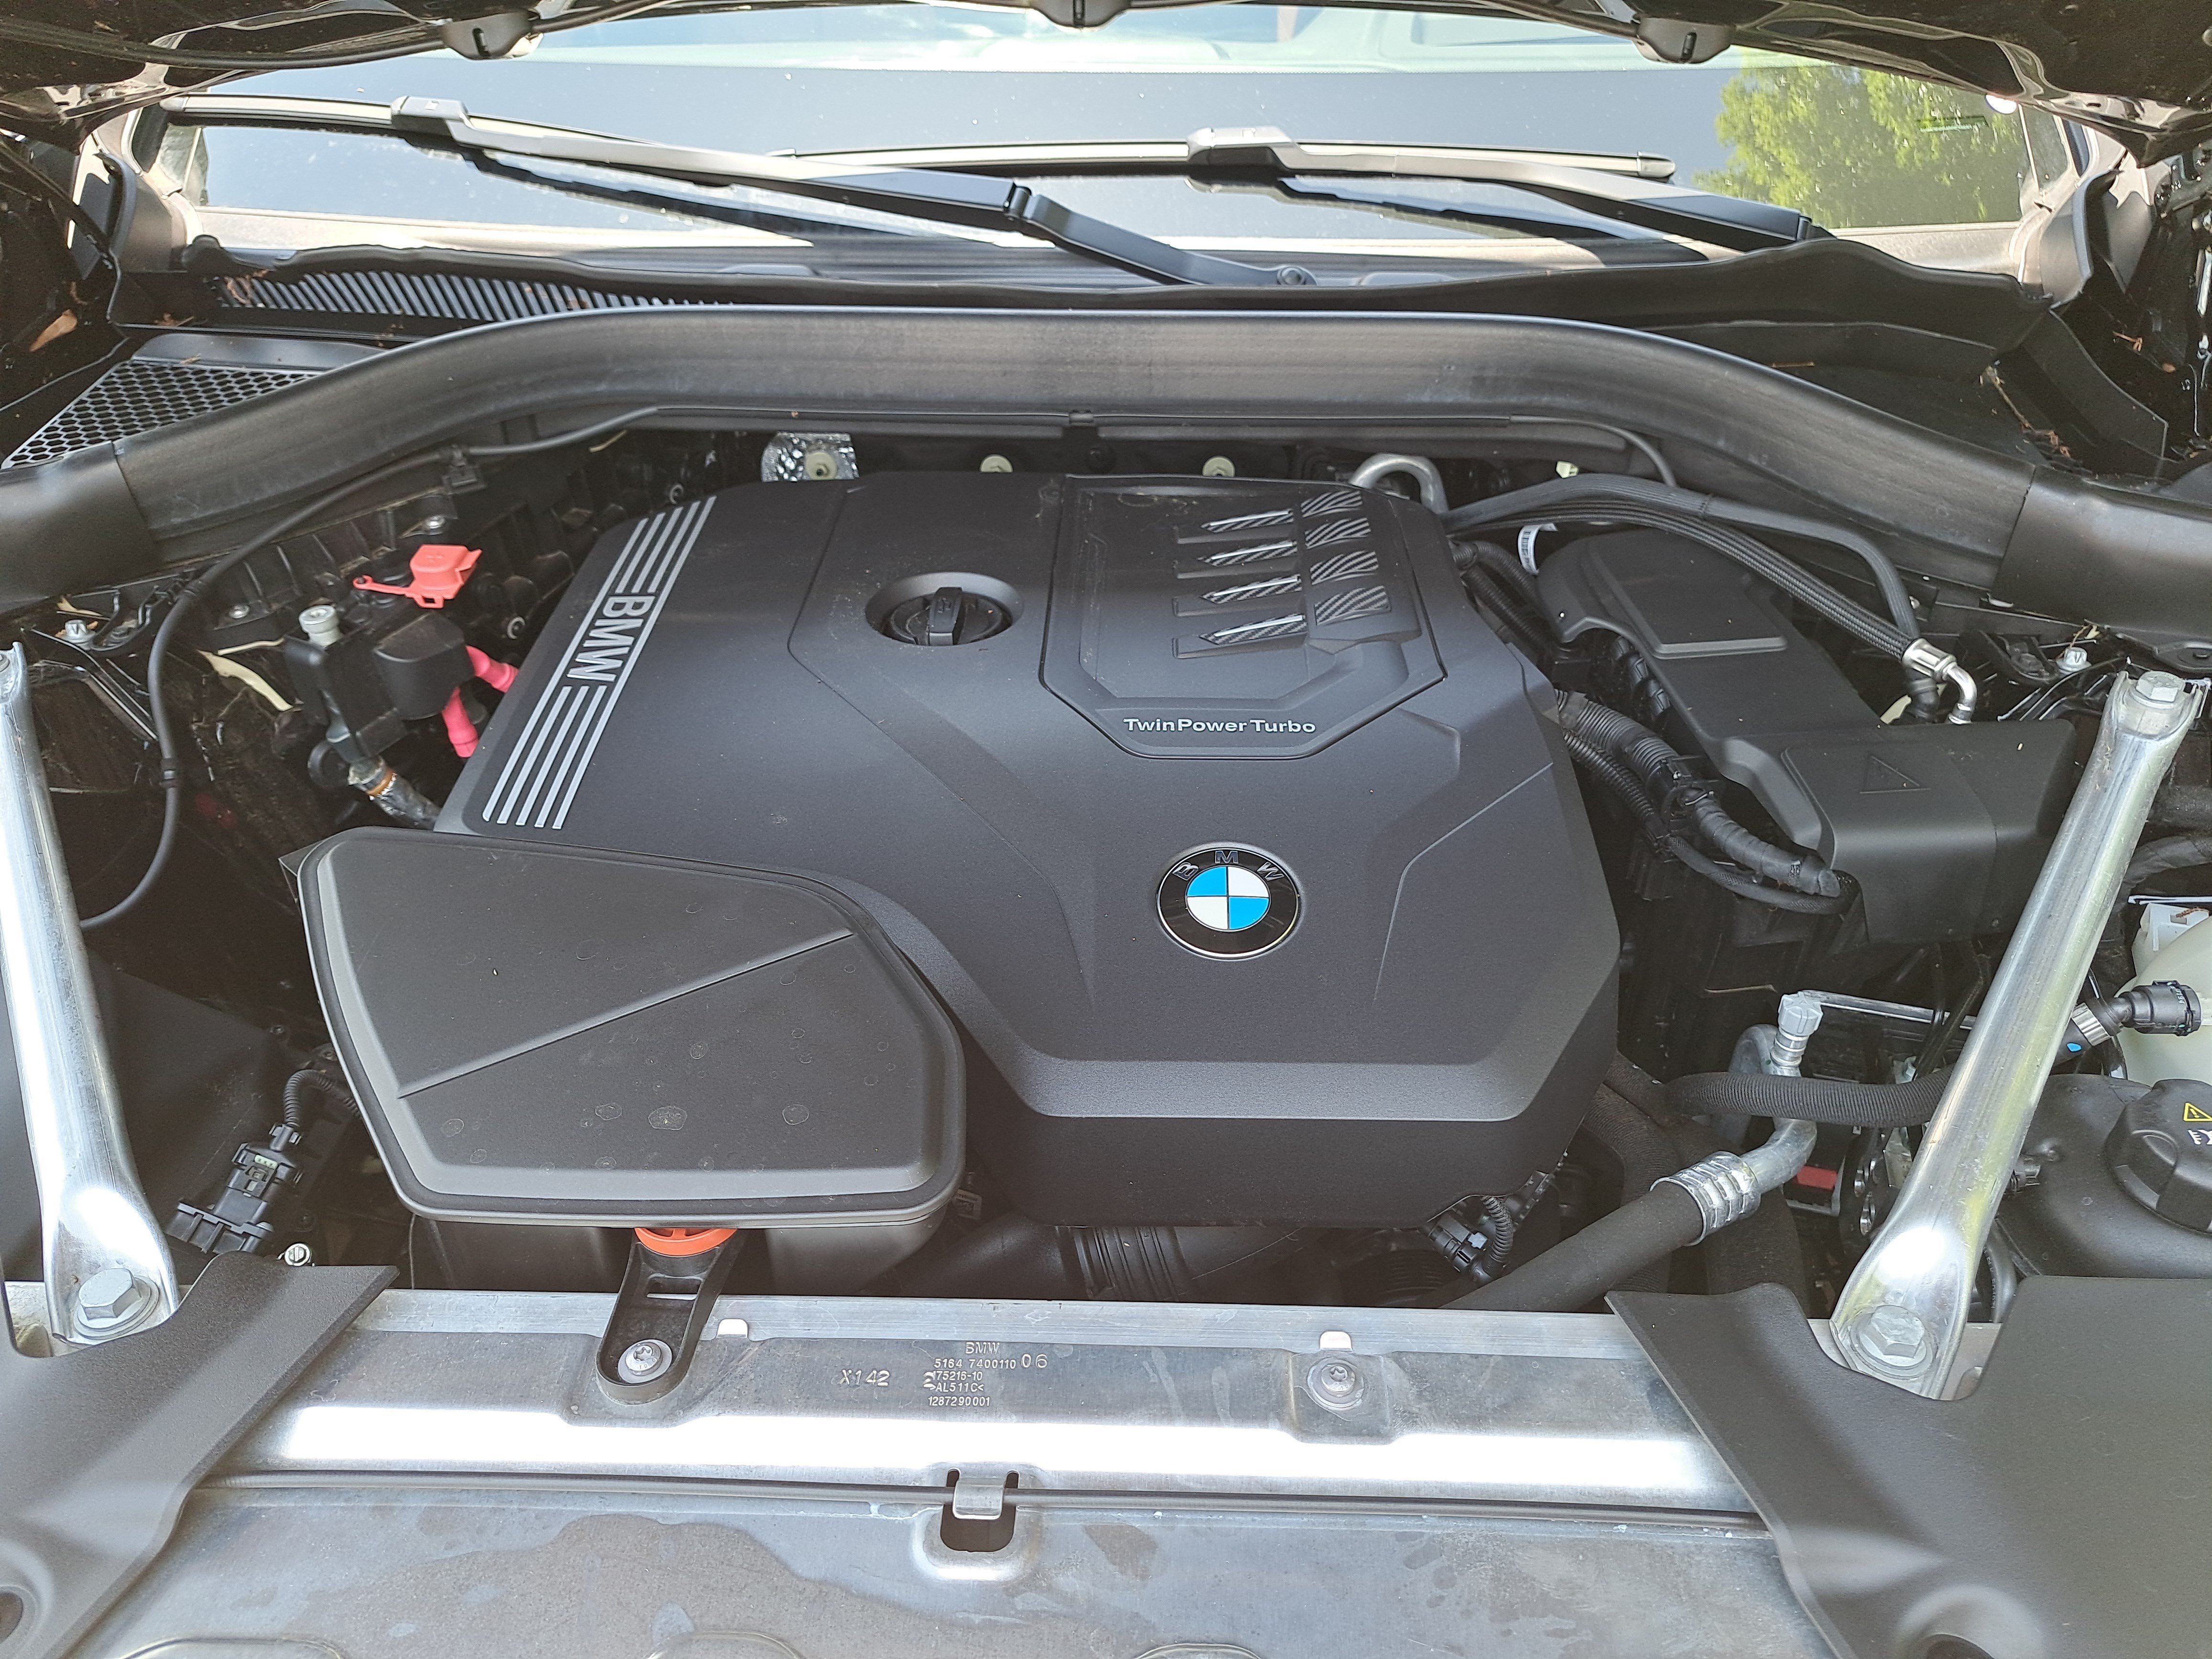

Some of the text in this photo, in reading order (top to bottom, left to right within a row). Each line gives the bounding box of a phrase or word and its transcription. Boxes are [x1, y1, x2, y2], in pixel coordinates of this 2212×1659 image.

[567, 596, 655, 682] BMW
[1250, 719, 1316, 733] Turbo
[1172, 850, 1285, 881] BMW
[965, 1341, 1000, 1354] BMW
[933, 1358, 962, 1369] 5164
[969, 1359, 1016, 1370] 7400110
[837, 1369, 890, 1387] X142
[928, 1396, 990, 1406] 1287290001
